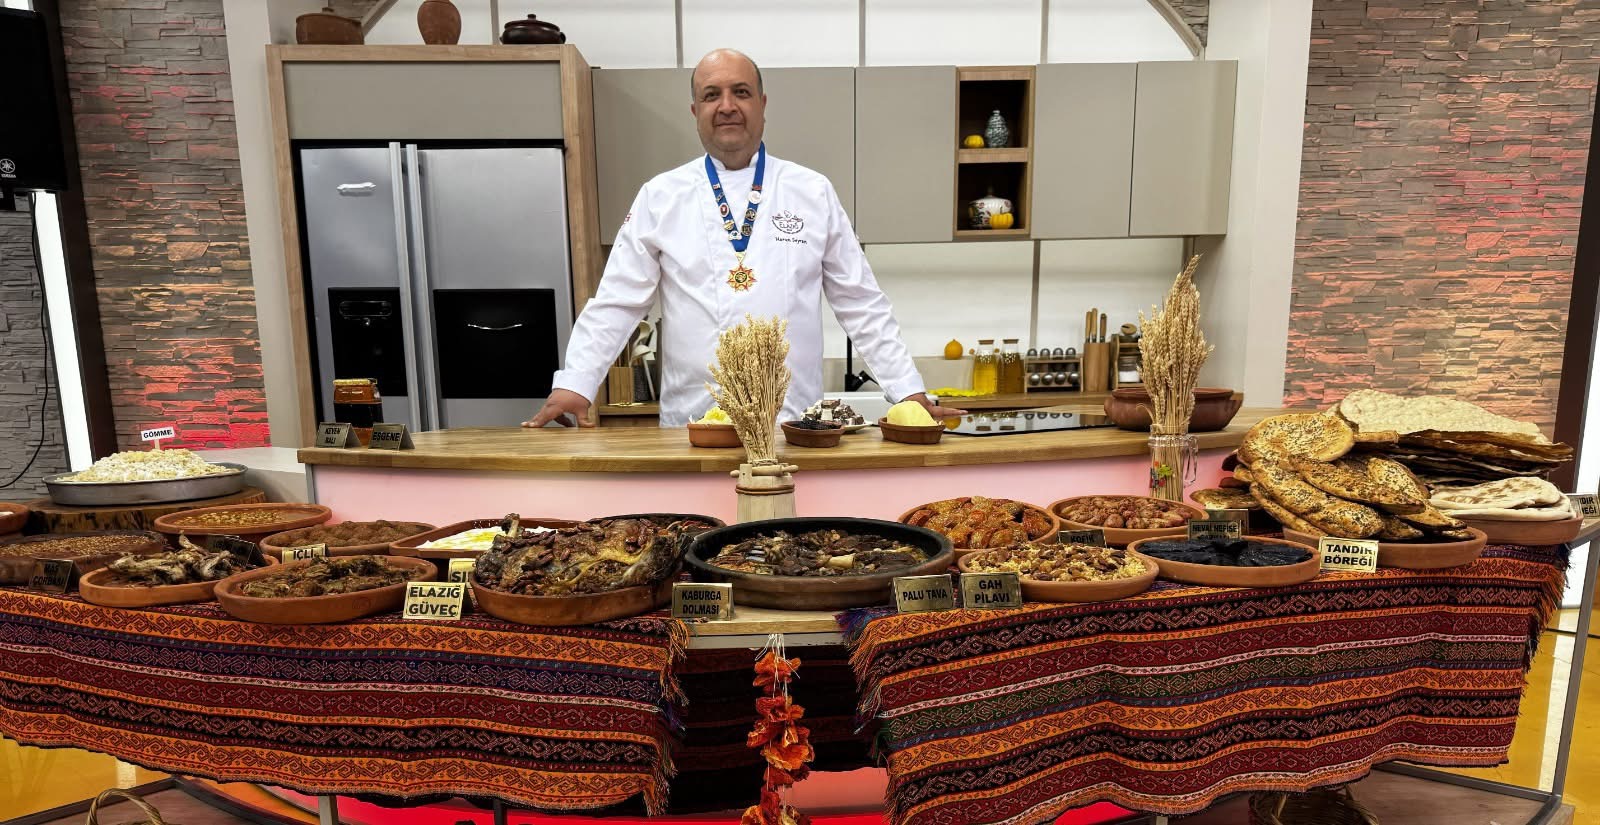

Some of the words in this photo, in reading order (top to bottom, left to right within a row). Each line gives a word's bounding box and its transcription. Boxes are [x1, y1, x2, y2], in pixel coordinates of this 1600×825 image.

[1326, 544, 1373, 555] TANDIR
[1324, 554, 1372, 567] BÖREĞİ
[979, 579, 1003, 590] GAH
[409, 585, 461, 598] ELAZIĞ
[681, 590, 722, 601] KABURGA
[902, 591, 924, 601] PALU
[925, 589, 948, 599] TAVA
[974, 592, 1010, 604] PİLAVI
[408, 601, 458, 616] GÜVEÇ
[682, 604, 720, 615] DOLMASI
